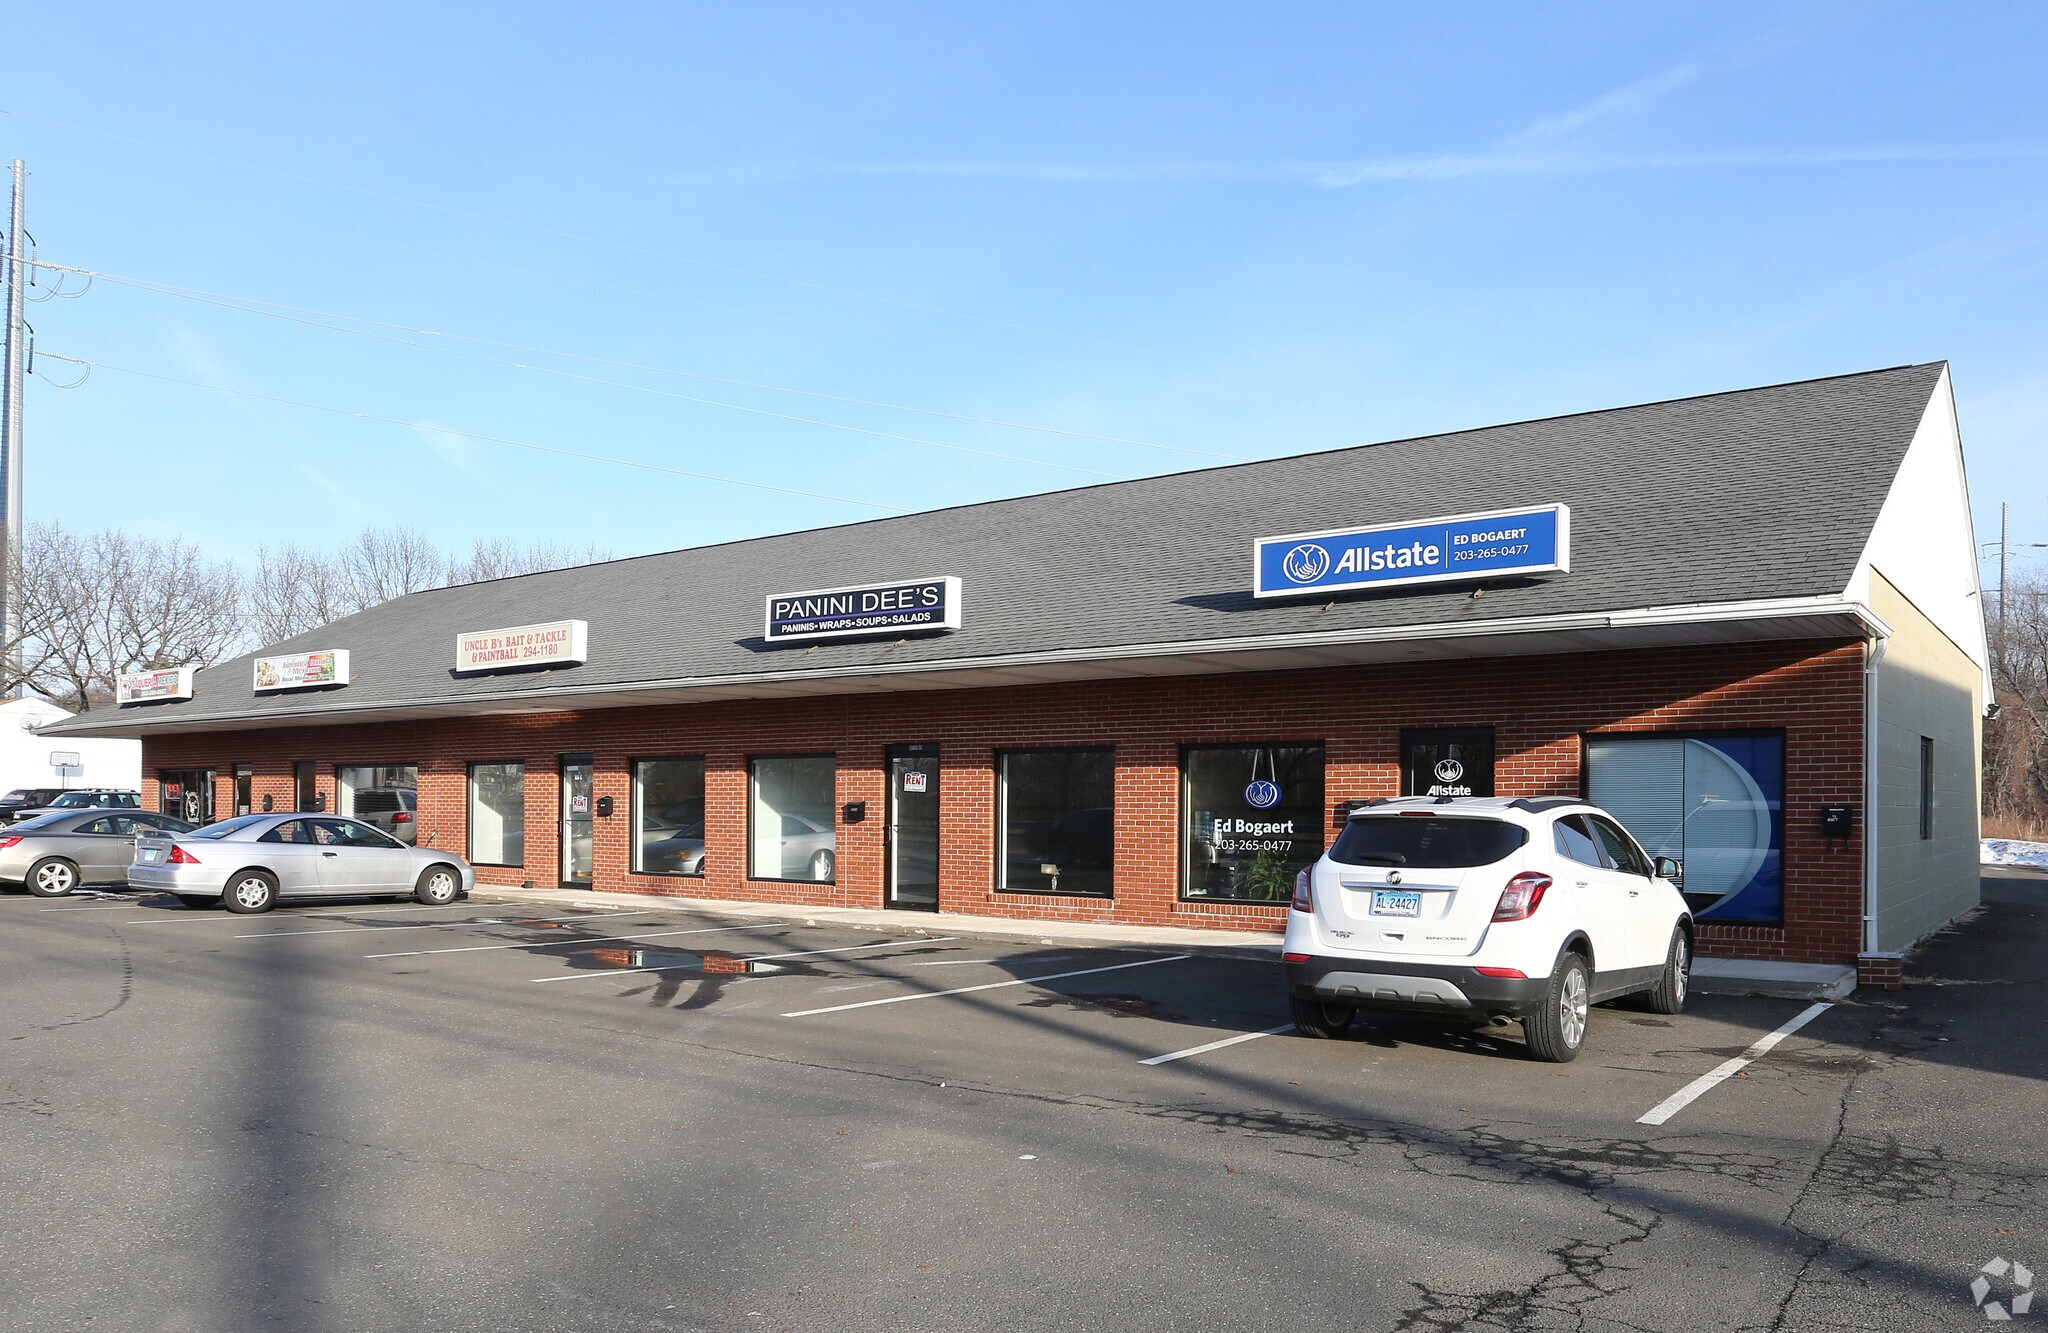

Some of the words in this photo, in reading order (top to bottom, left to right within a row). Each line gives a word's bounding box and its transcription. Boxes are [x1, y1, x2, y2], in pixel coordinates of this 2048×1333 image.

[1453, 534, 1469, 546] ED
[1471, 527, 1527, 544] BOGAERT
[1333, 541, 1439, 574] Allstate
[1453, 544, 1529, 562] 203-265-0477
[775, 594, 853, 620] PANINI
[862, 586, 939, 612] DEE'S
[464, 638, 488, 652] UNCLE
[505, 635, 525, 647] BAIT
[527, 634, 533, 645] &
[535, 630, 567, 643] TACKLE
[478, 648, 519, 662] PAINTBALL
[523, 643, 558, 658] 294-1180
[906, 774, 925, 785] RENT
[1426, 784, 1471, 797] Allstate
[1214, 818, 1231, 833] Ed
[1235, 818, 1294, 836] Bogaert
[1214, 839, 1292, 851] 203-265-0477
